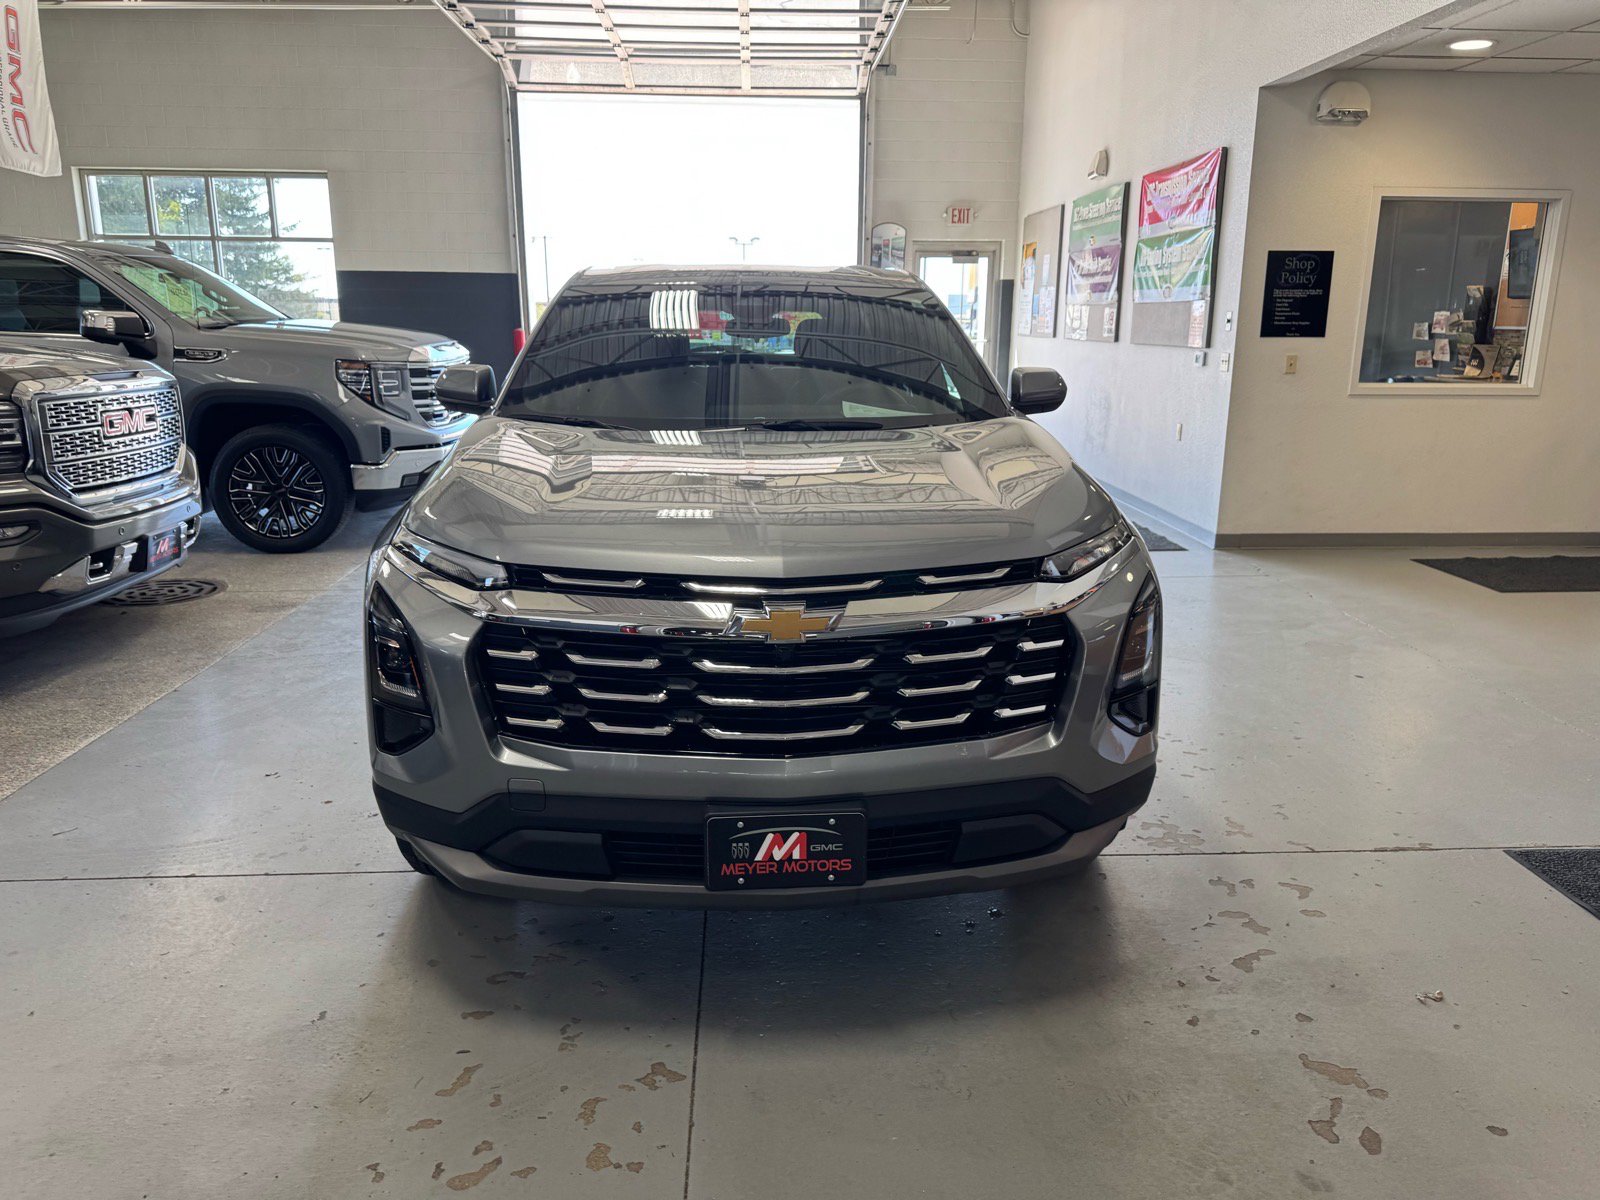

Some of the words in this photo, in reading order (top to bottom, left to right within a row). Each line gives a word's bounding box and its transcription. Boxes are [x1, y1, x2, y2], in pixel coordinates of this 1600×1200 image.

[4, 5, 37, 154] GMC
[951, 207, 971, 224] EXIT
[1285, 257, 1315, 273] Shop
[1281, 272, 1317, 287] Policy
[103, 406, 157, 436] GMC
[810, 843, 844, 851] GMC
[721, 862, 778, 876] MEYER
[783, 859, 852, 873] MOTORS
